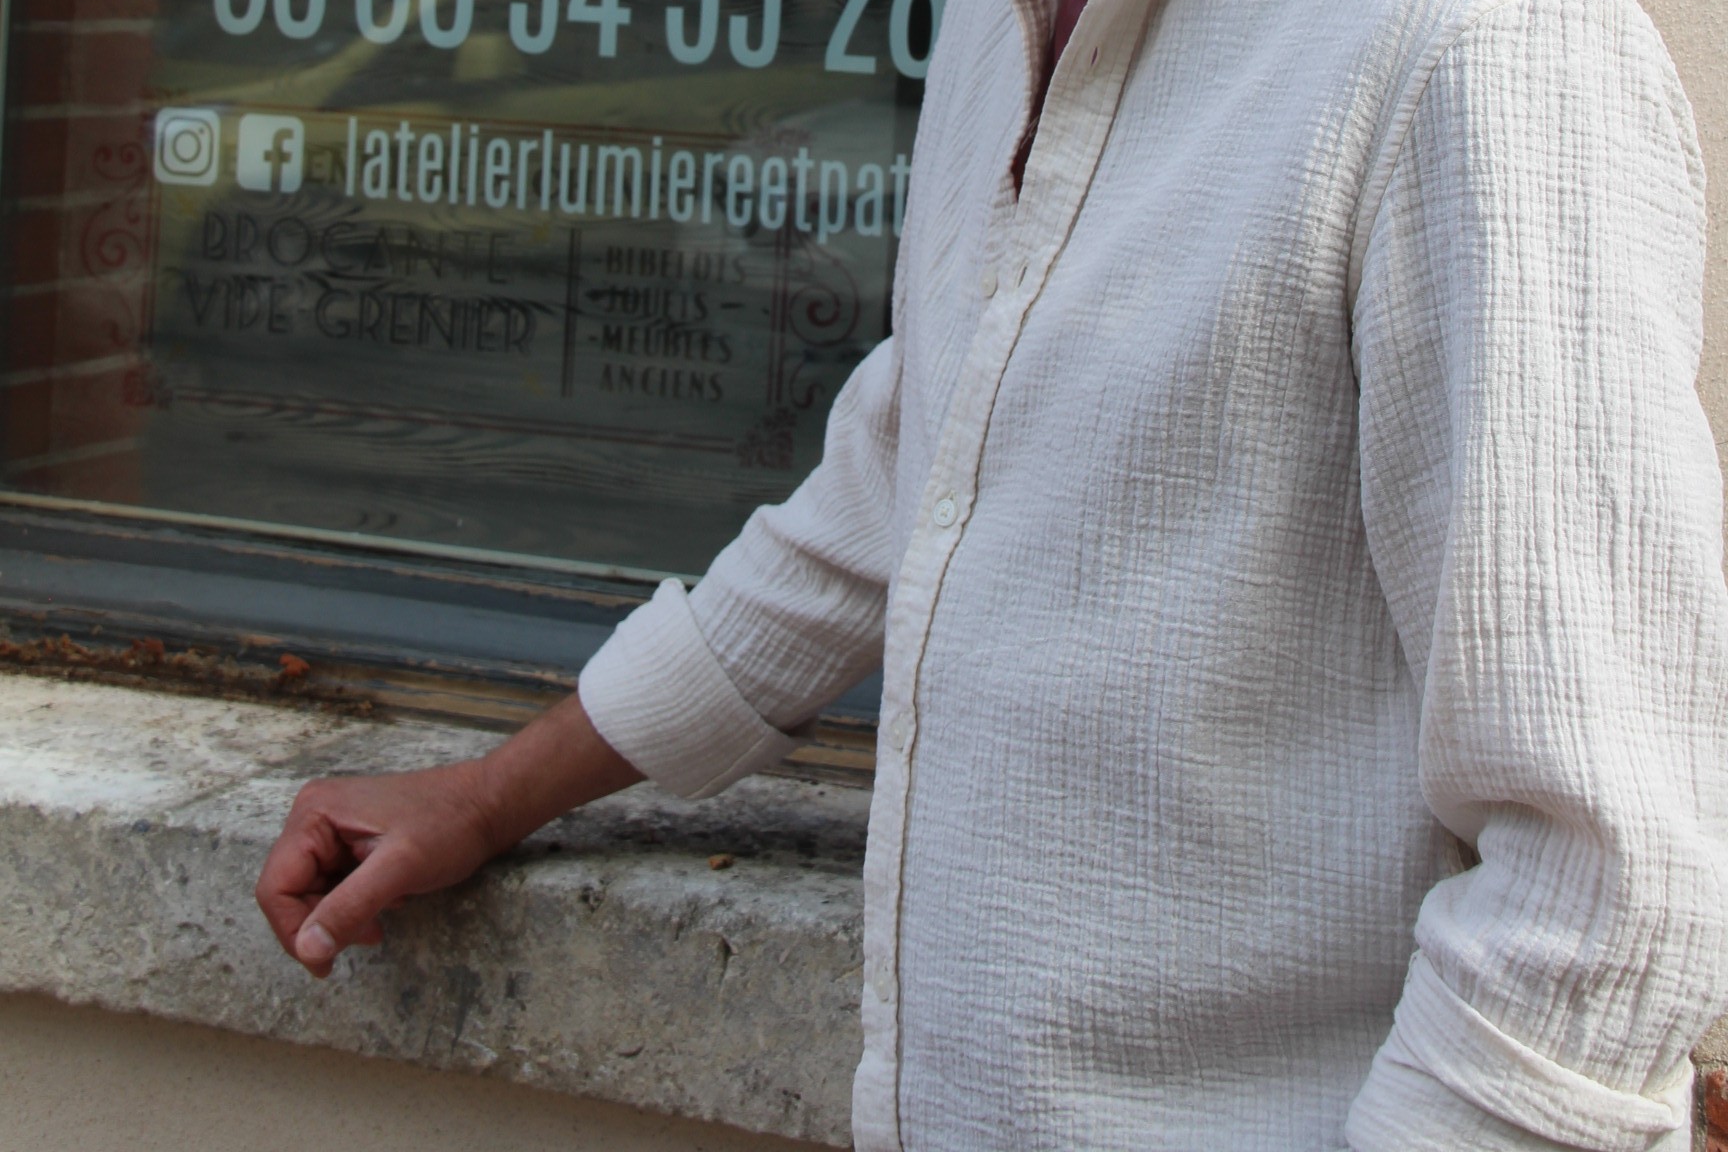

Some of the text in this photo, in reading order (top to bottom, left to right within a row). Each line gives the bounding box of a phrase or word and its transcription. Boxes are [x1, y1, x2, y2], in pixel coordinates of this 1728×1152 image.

[344, 116, 912, 245] latelierlumiereetpat
[201, 210, 515, 285] BROCANTE
[602, 362, 725, 403] ANCIENS
